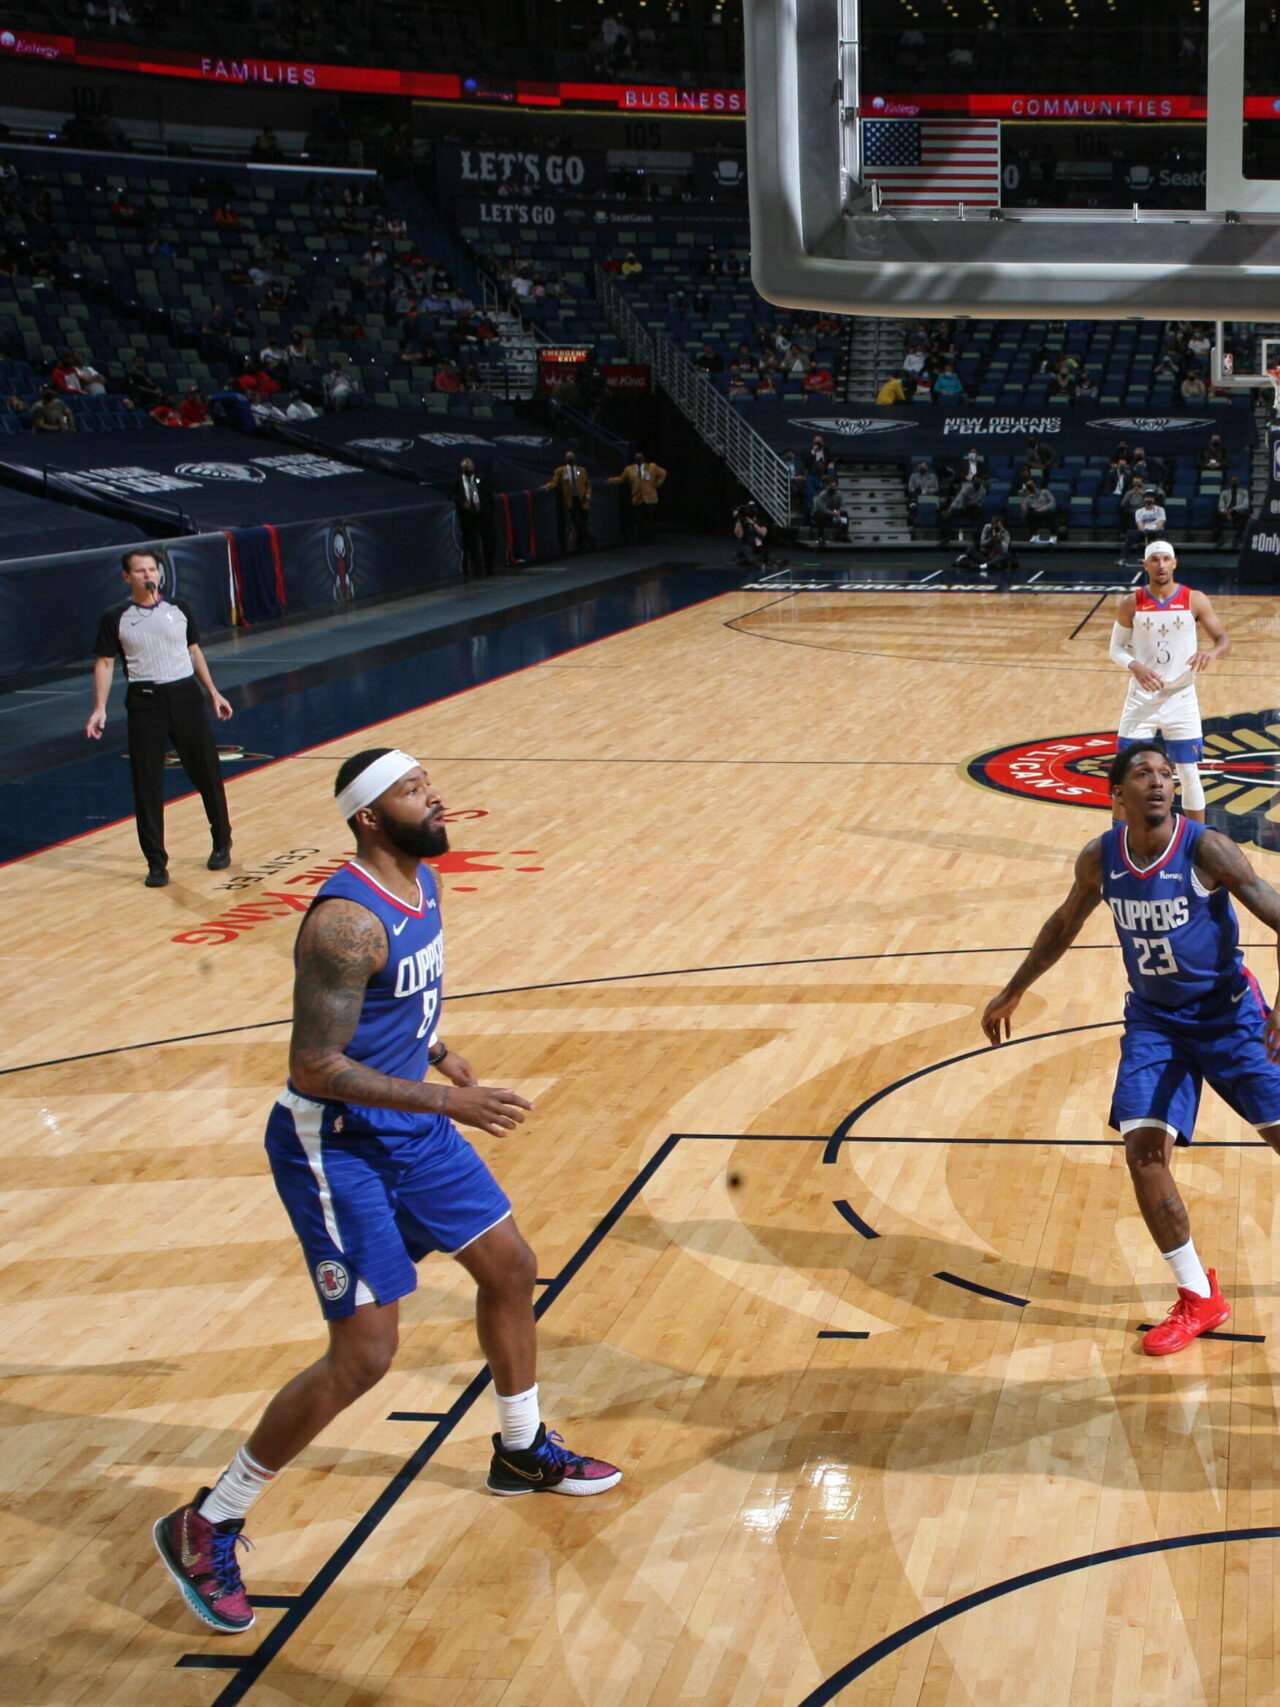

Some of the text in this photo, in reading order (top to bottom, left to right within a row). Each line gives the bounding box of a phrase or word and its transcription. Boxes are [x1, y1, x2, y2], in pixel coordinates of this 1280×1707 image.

[200, 58, 316, 86] FAMILIES
[1012, 99, 1173, 116] COMMUNITIES
[460, 149, 585, 185] LET'S GO
[480, 203, 529, 223] LET'S
[532, 205, 556, 224] GO
[943, 424, 1061, 435] PELICANS
[945, 416, 1061, 425] NEW ORLEANS
[213, 847, 321, 891] CENTER
[1108, 895, 1190, 931] CLIPPERS
[1132, 937, 1179, 975] 23
